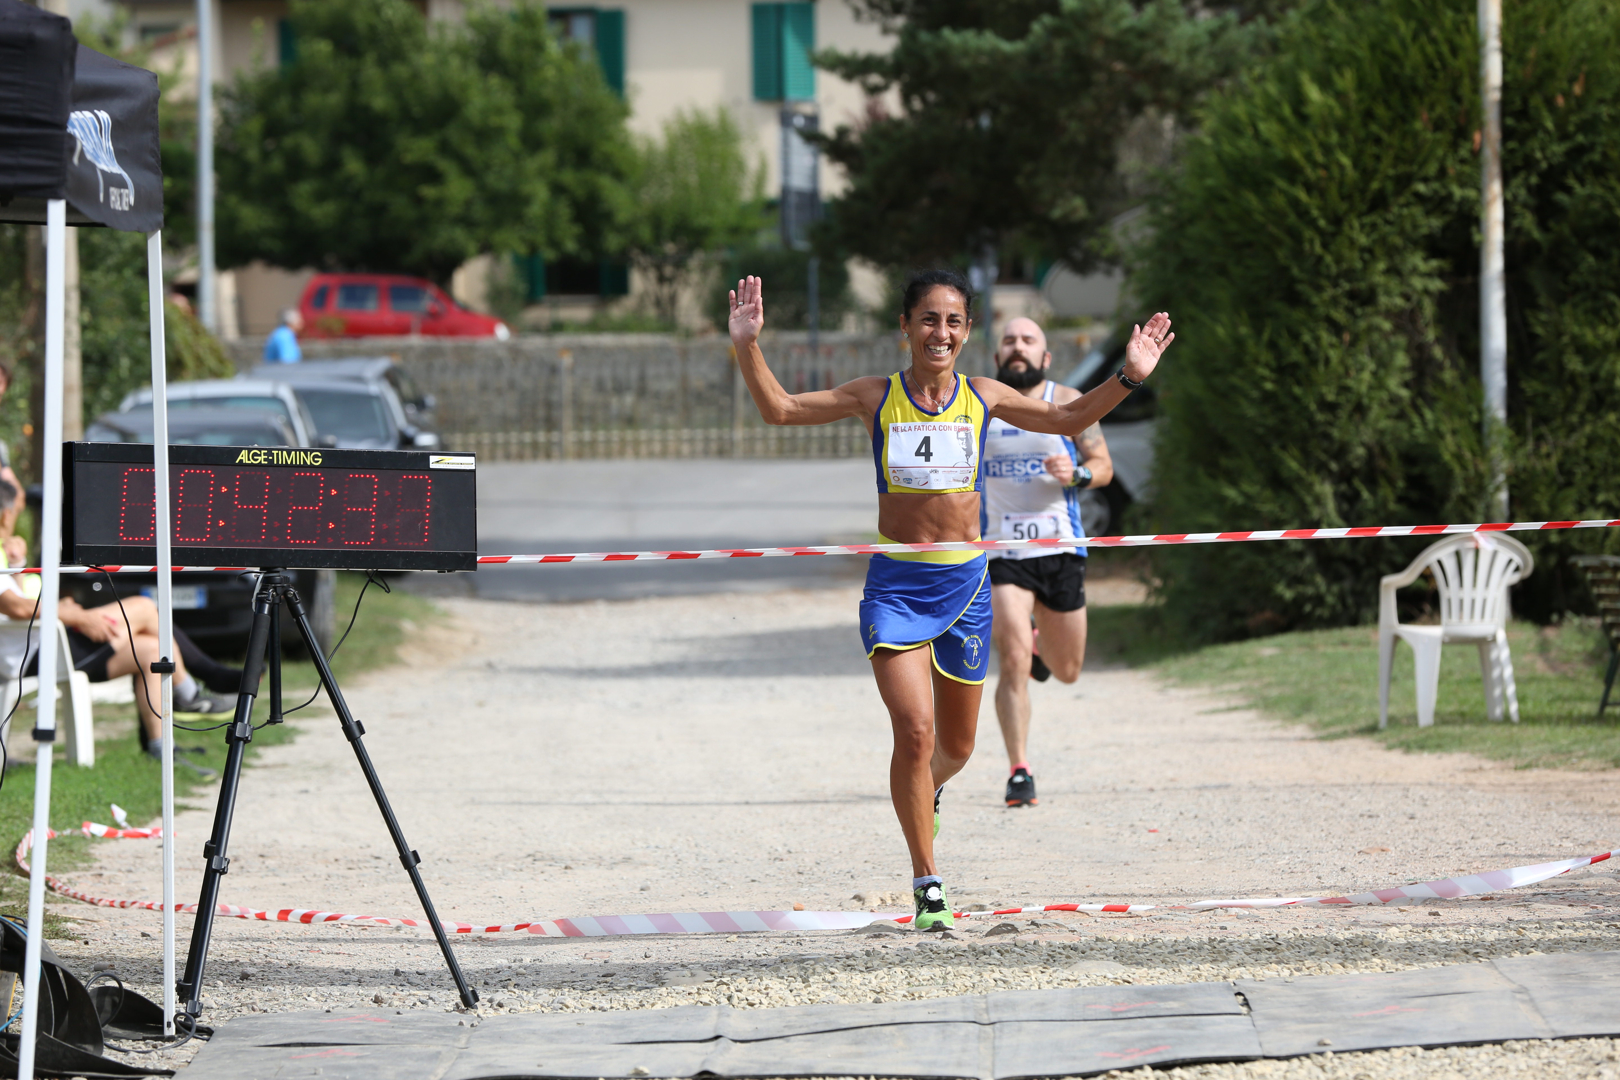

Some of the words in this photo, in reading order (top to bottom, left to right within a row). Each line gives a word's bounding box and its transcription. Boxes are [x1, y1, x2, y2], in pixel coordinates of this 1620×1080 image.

[235, 449, 323, 466] ALGE-TIMING
[914, 435, 933, 462] 4
[1013, 522, 1039, 540] 50
